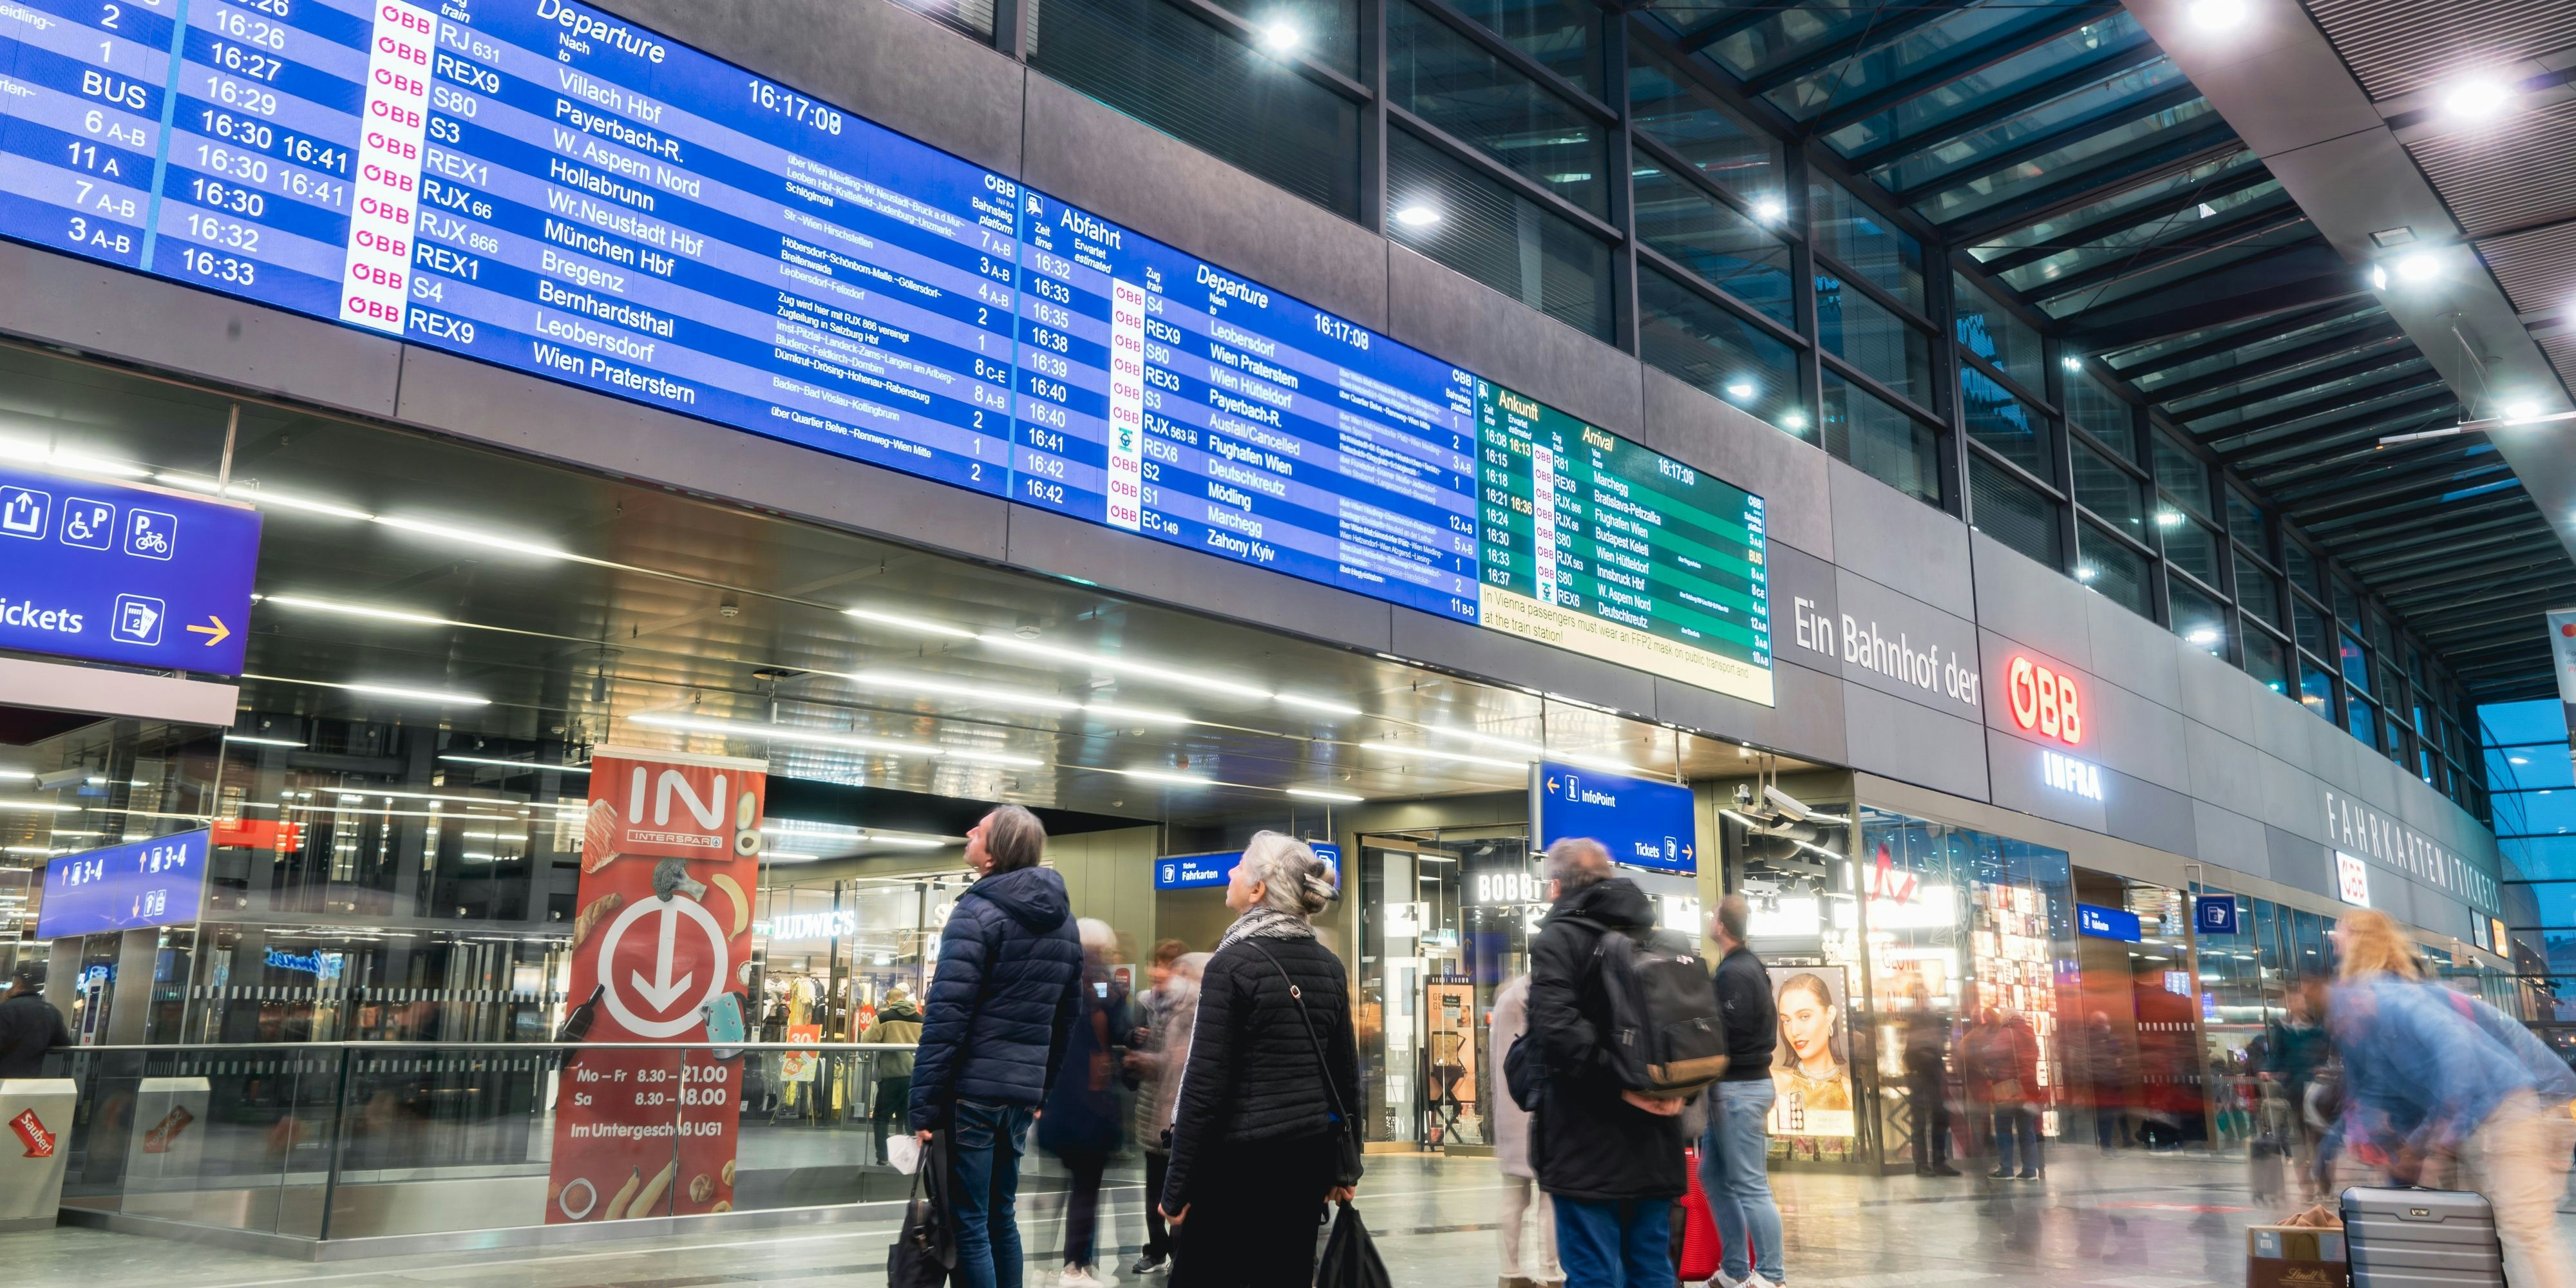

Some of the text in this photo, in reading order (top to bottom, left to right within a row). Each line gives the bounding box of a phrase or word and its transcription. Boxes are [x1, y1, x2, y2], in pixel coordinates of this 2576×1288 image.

[216, 10, 285, 49] 16:26
[440, 23, 500, 64] RJ 631
[536, 0, 666, 64] Departure
[560, 31, 589, 55] Nach
[211, 43, 281, 81] 16:27
[437, 53, 500, 94] REX9
[82, 70, 146, 109] BUS
[207, 77, 276, 115] 16:29
[433, 86, 477, 118] S80
[559, 68, 661, 124] Villach Hbf
[202, 110, 347, 173] 16:30 16:41
[430, 117, 460, 144] S3
[556, 99, 683, 162] Payerbach-R.
[68, 142, 119, 176] 11 A
[198, 145, 342, 207] 16:30 16:41
[426, 149, 488, 186] REX1
[553, 129, 699, 198] W. Aspern Nord
[75, 180, 135, 218] 7 A-B
[193, 179, 263, 218] 16:30
[423, 180, 491, 220] RJX 66
[551, 158, 654, 211] Hollabrunn
[786, 182, 833, 207] Schlöglmühl
[972, 196, 1013, 224] Bahnsteig
[187, 213, 259, 252] 16:32
[420, 211, 498, 254] RJX 866
[545, 218, 674, 277] München Hbf
[1061, 209, 1121, 250] Abfahrt
[183, 248, 254, 285] 16:33
[416, 243, 478, 280] REX1
[542, 249, 624, 293] Bregenz
[1035, 253, 1070, 280] 16:32
[413, 277, 442, 303] S4
[1034, 278, 1070, 304] 16:33
[1197, 265, 1268, 309] Departure
[410, 307, 474, 345] REX9
[540, 280, 674, 337] Bernhardsthal
[778, 292, 910, 343] Zug wird hier mit RJX 866 vereinigt
[1034, 303, 1069, 328] 16:35
[536, 312, 654, 362] Leobersdorf
[1032, 327, 1068, 353] 16:38
[1211, 320, 1275, 358] Leobersdorf
[533, 343, 694, 404] Wien Praterstern
[1031, 352, 1066, 378] 16:39
[1210, 343, 1298, 390] Wien Praterstern
[1030, 377, 1066, 402] 16:40
[1210, 365, 1292, 409] Wien Hütteldorf
[1030, 402, 1065, 428] 16:40
[1210, 388, 1282, 428] Payerbach-R.
[1499, 390, 1539, 422] Ankunft
[1029, 428, 1063, 453] 16:41
[1209, 413, 1300, 457] Ausfall/Cancelled
[1485, 428, 1531, 457] 16:08 16:13
[1582, 426, 1613, 452] Arrival
[1028, 453, 1064, 479] 16:42
[1209, 435, 1292, 476] Flughafen Wien
[1485, 448, 1507, 468] 16:15
[1027, 479, 1063, 504] 16:42
[1209, 459, 1285, 497] Deutschkreutz
[1486, 468, 1508, 487] 16:18
[1594, 471, 1628, 497] Marchegg
[1209, 482, 1251, 512] Mödling
[1486, 488, 1532, 515] 16:21 16:36
[1595, 491, 1661, 526] Bratislava-Petrzalka
[1208, 505, 1262, 538] Marchegg
[1595, 510, 1648, 538] Flughafen Wien
[1484, 589, 1493, 603] In
[1495, 592, 1524, 612] Vienna
[1528, 604, 1576, 628] passengers
[1578, 617, 1596, 631] must
[1598, 625, 1618, 637] wear
[1620, 632, 1629, 643] an
[1631, 632, 1652, 650] FFP2
[1654, 640, 1673, 656] mask
[1676, 648, 1683, 659] on
[1685, 647, 1705, 665] public
[1707, 654, 1735, 676] transport
[1738, 663, 1748, 678] and
[1485, 611, 1563, 643] at the train station!
[1598, 602, 1648, 629] Deutschkreutz
[1794, 596, 1978, 706] Ein Bahnhof der
[2009, 656, 2081, 744] ÖBB
[2042, 750, 2102, 800] INFRA
[629, 766, 727, 830] IN
[1582, 790, 1615, 807] InfoPoint
[164, 844, 186, 870] 3-4
[635, 832, 710, 845] INTERSPAR
[1635, 842, 1660, 858] Tickets
[2326, 792, 2446, 887] FAHRKARTEN
[2455, 858, 2499, 914] TICKETS
[83, 859, 103, 883] 3-4
[1182, 870, 1218, 880] Fahrkarten
[773, 910, 855, 940] LUDWIG'S
[860, 1012, 871, 1024] 30
[577, 1069, 599, 1083] Mo
[615, 1070, 627, 1083] Fr
[638, 1069, 666, 1083] 8.30
[683, 1066, 727, 1083] 21.00
[574, 1093, 592, 1106] Sa
[635, 1092, 664, 1106] 8.30
[681, 1088, 726, 1106] 18.00
[21, 1113, 52, 1155] Sauber!
[571, 1123, 589, 1137] Im
[695, 1122, 722, 1136] UG1
